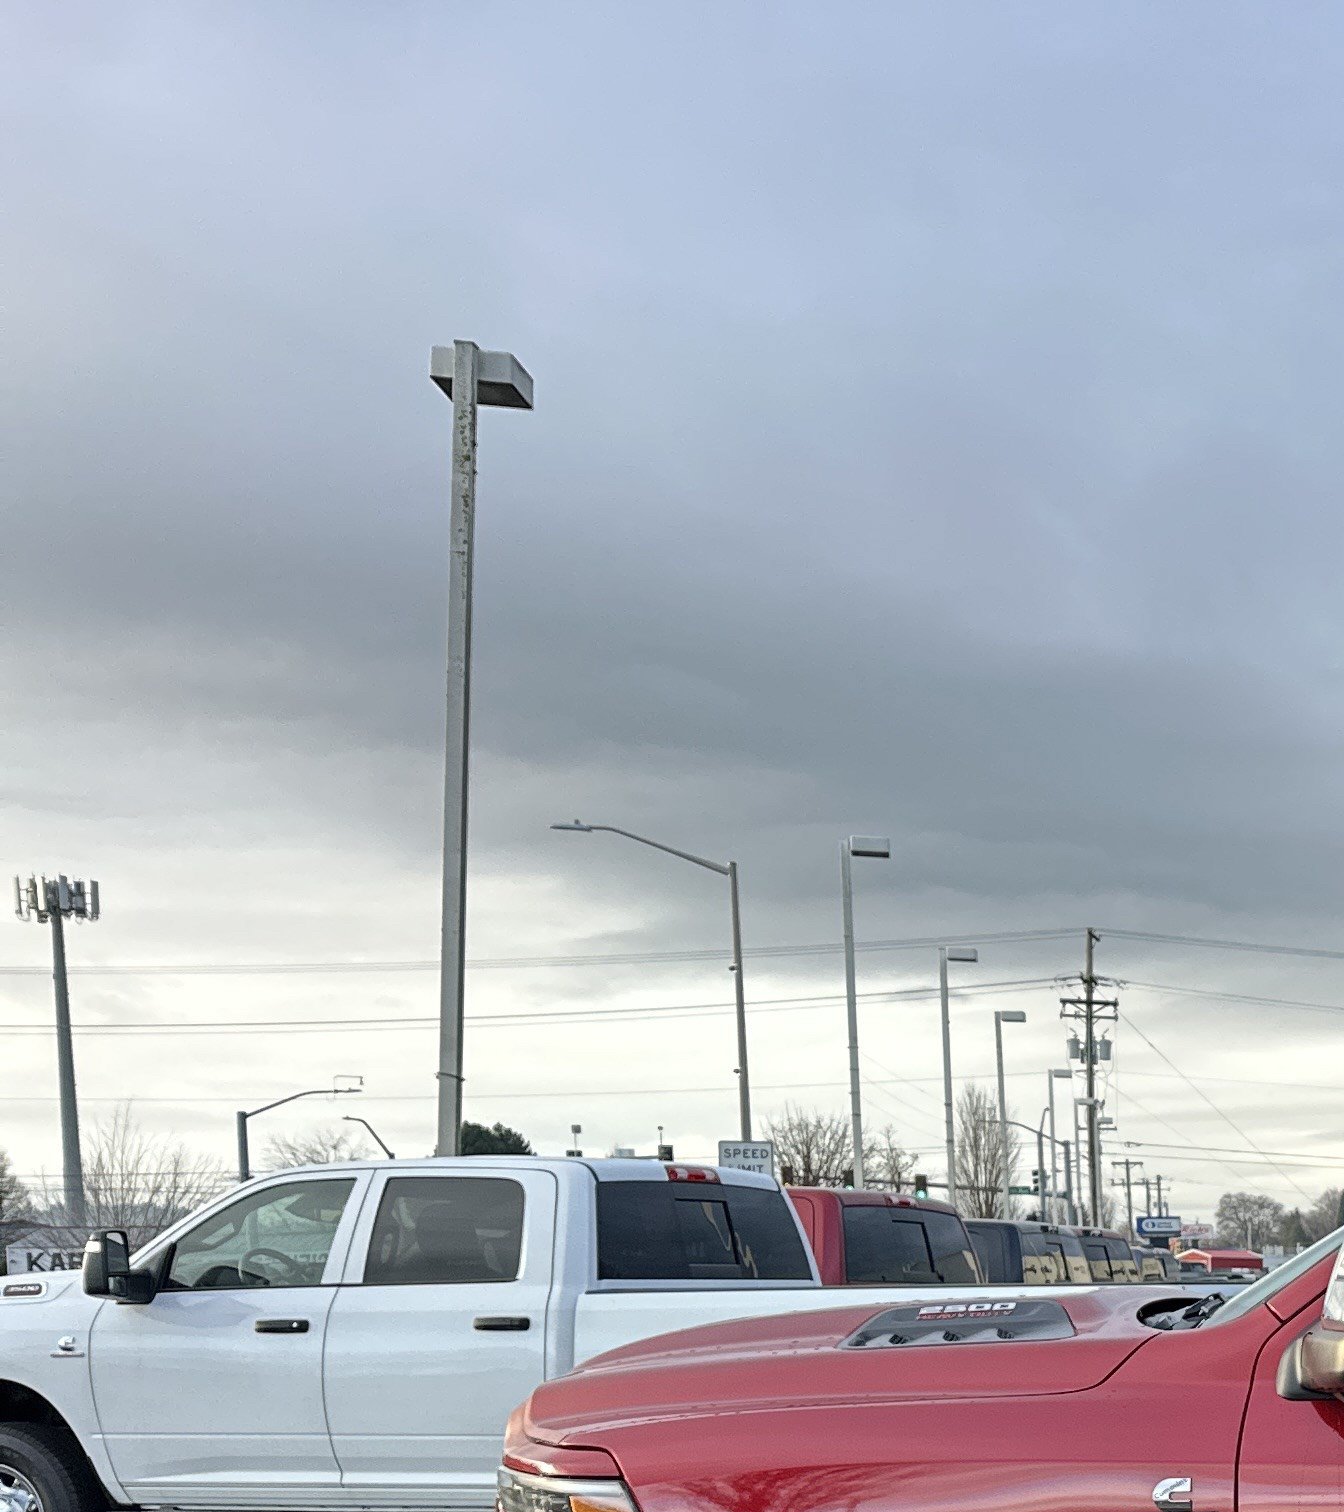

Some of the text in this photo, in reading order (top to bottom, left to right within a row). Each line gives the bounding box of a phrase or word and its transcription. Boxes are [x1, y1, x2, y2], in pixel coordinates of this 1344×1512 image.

[723, 1148, 769, 1159] SPEED
[728, 1164, 764, 1174] MIT
[918, 1302, 1017, 1314] 2500
[1154, 1478, 1189, 1499] Cummins
